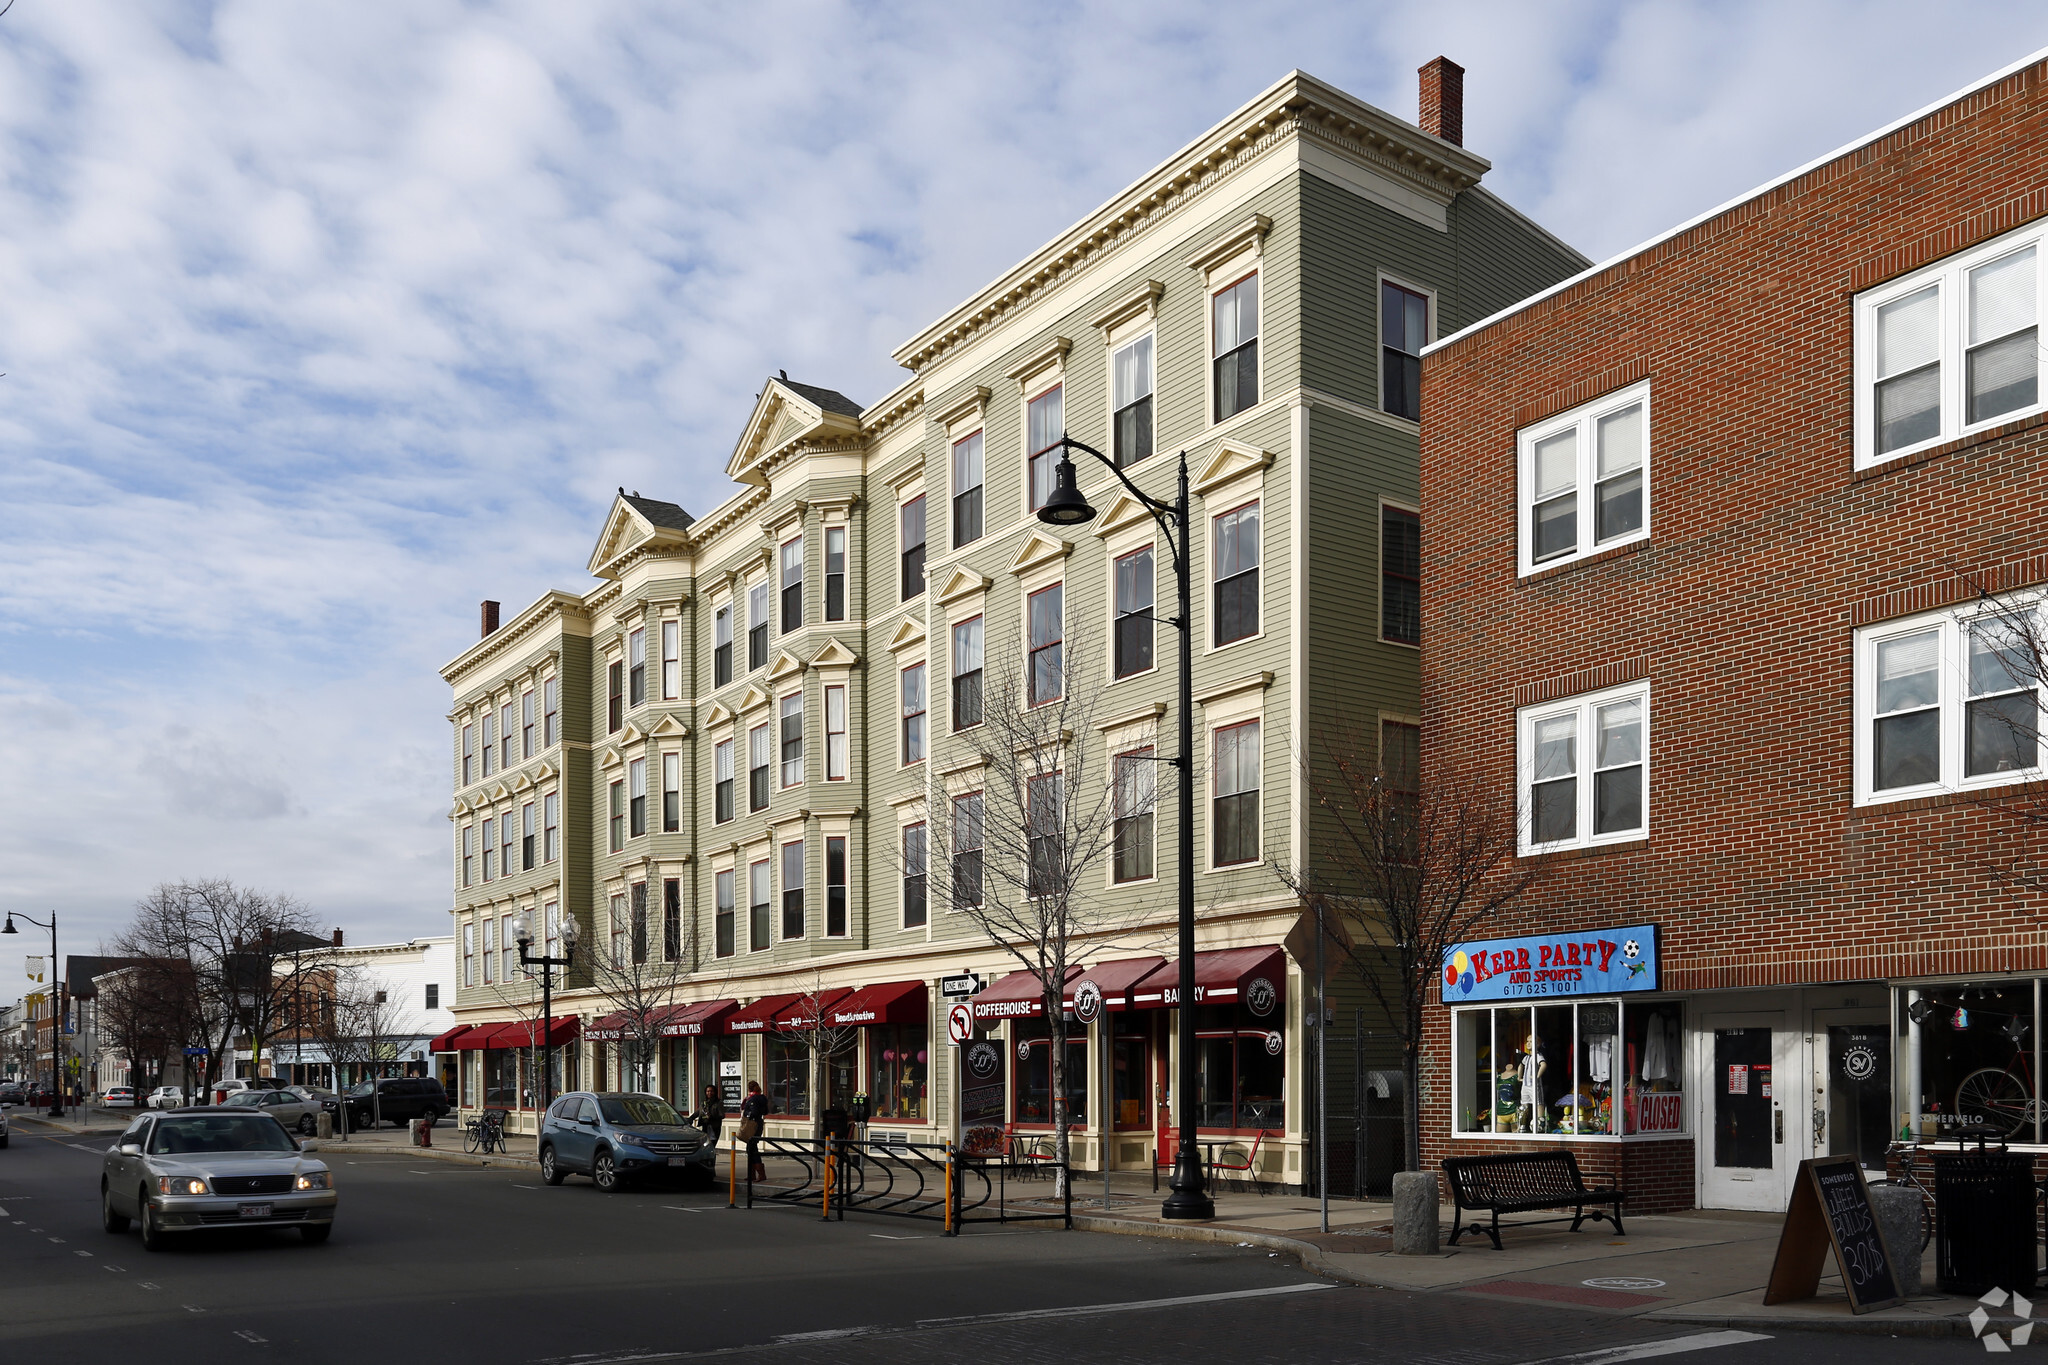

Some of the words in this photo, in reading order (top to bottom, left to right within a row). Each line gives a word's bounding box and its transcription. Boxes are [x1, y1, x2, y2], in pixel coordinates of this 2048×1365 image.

[1470, 947, 1531, 984] KERR
[1538, 939, 1617, 973] PARTY
[1508, 970, 1531, 984] AND
[1533, 968, 1583, 983] SPORTS
[945, 982, 957, 991] ONE
[957, 980, 969, 990] WAY
[1248, 979, 1275, 998] FORTISSIMO
[1503, 984, 1523, 996] 617
[1526, 982, 1547, 994] 625
[1551, 981, 1578, 992] 1001
[1164, 986, 1205, 1004] BARY
[975, 1001, 1031, 1017] COFFEEHOUSE
[1581, 1012, 1617, 1026] OPEN
[660, 1024, 679, 1035] COME
[678, 1024, 689, 1035] TAX
[688, 1023, 701, 1034] PLUS
[968, 1043, 997, 1061] FORTISSIMO
[1851, 1056, 1868, 1071] SV
[1640, 1095, 1681, 1131] CLOSED
[1919, 1114, 1984, 1124] SOMERVELO
[1821, 1172, 1855, 1185] SOMERVELO
[1833, 1208, 1873, 1244] BUILDS
